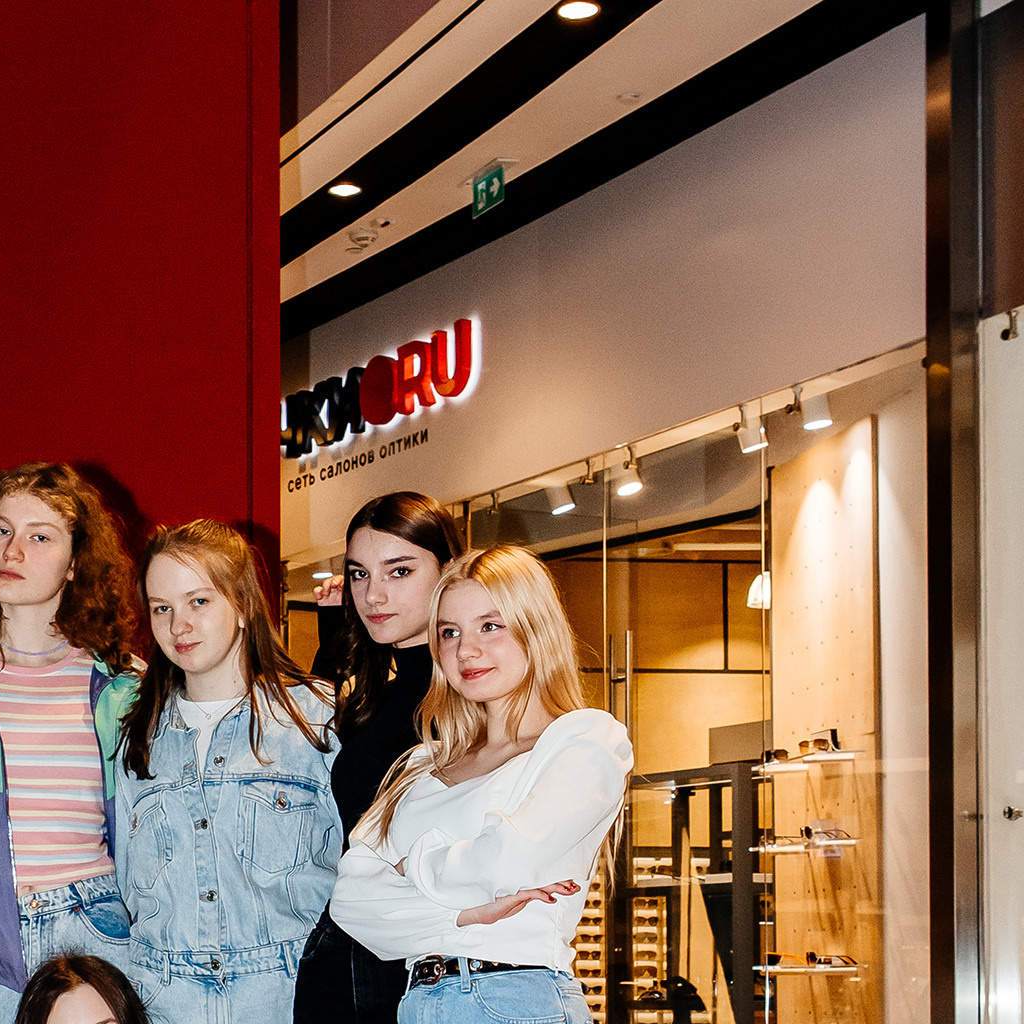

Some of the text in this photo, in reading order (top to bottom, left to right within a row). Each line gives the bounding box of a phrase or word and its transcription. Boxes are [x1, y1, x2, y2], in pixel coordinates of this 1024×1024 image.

[287, 428, 429, 493] сеть салонов оптики
